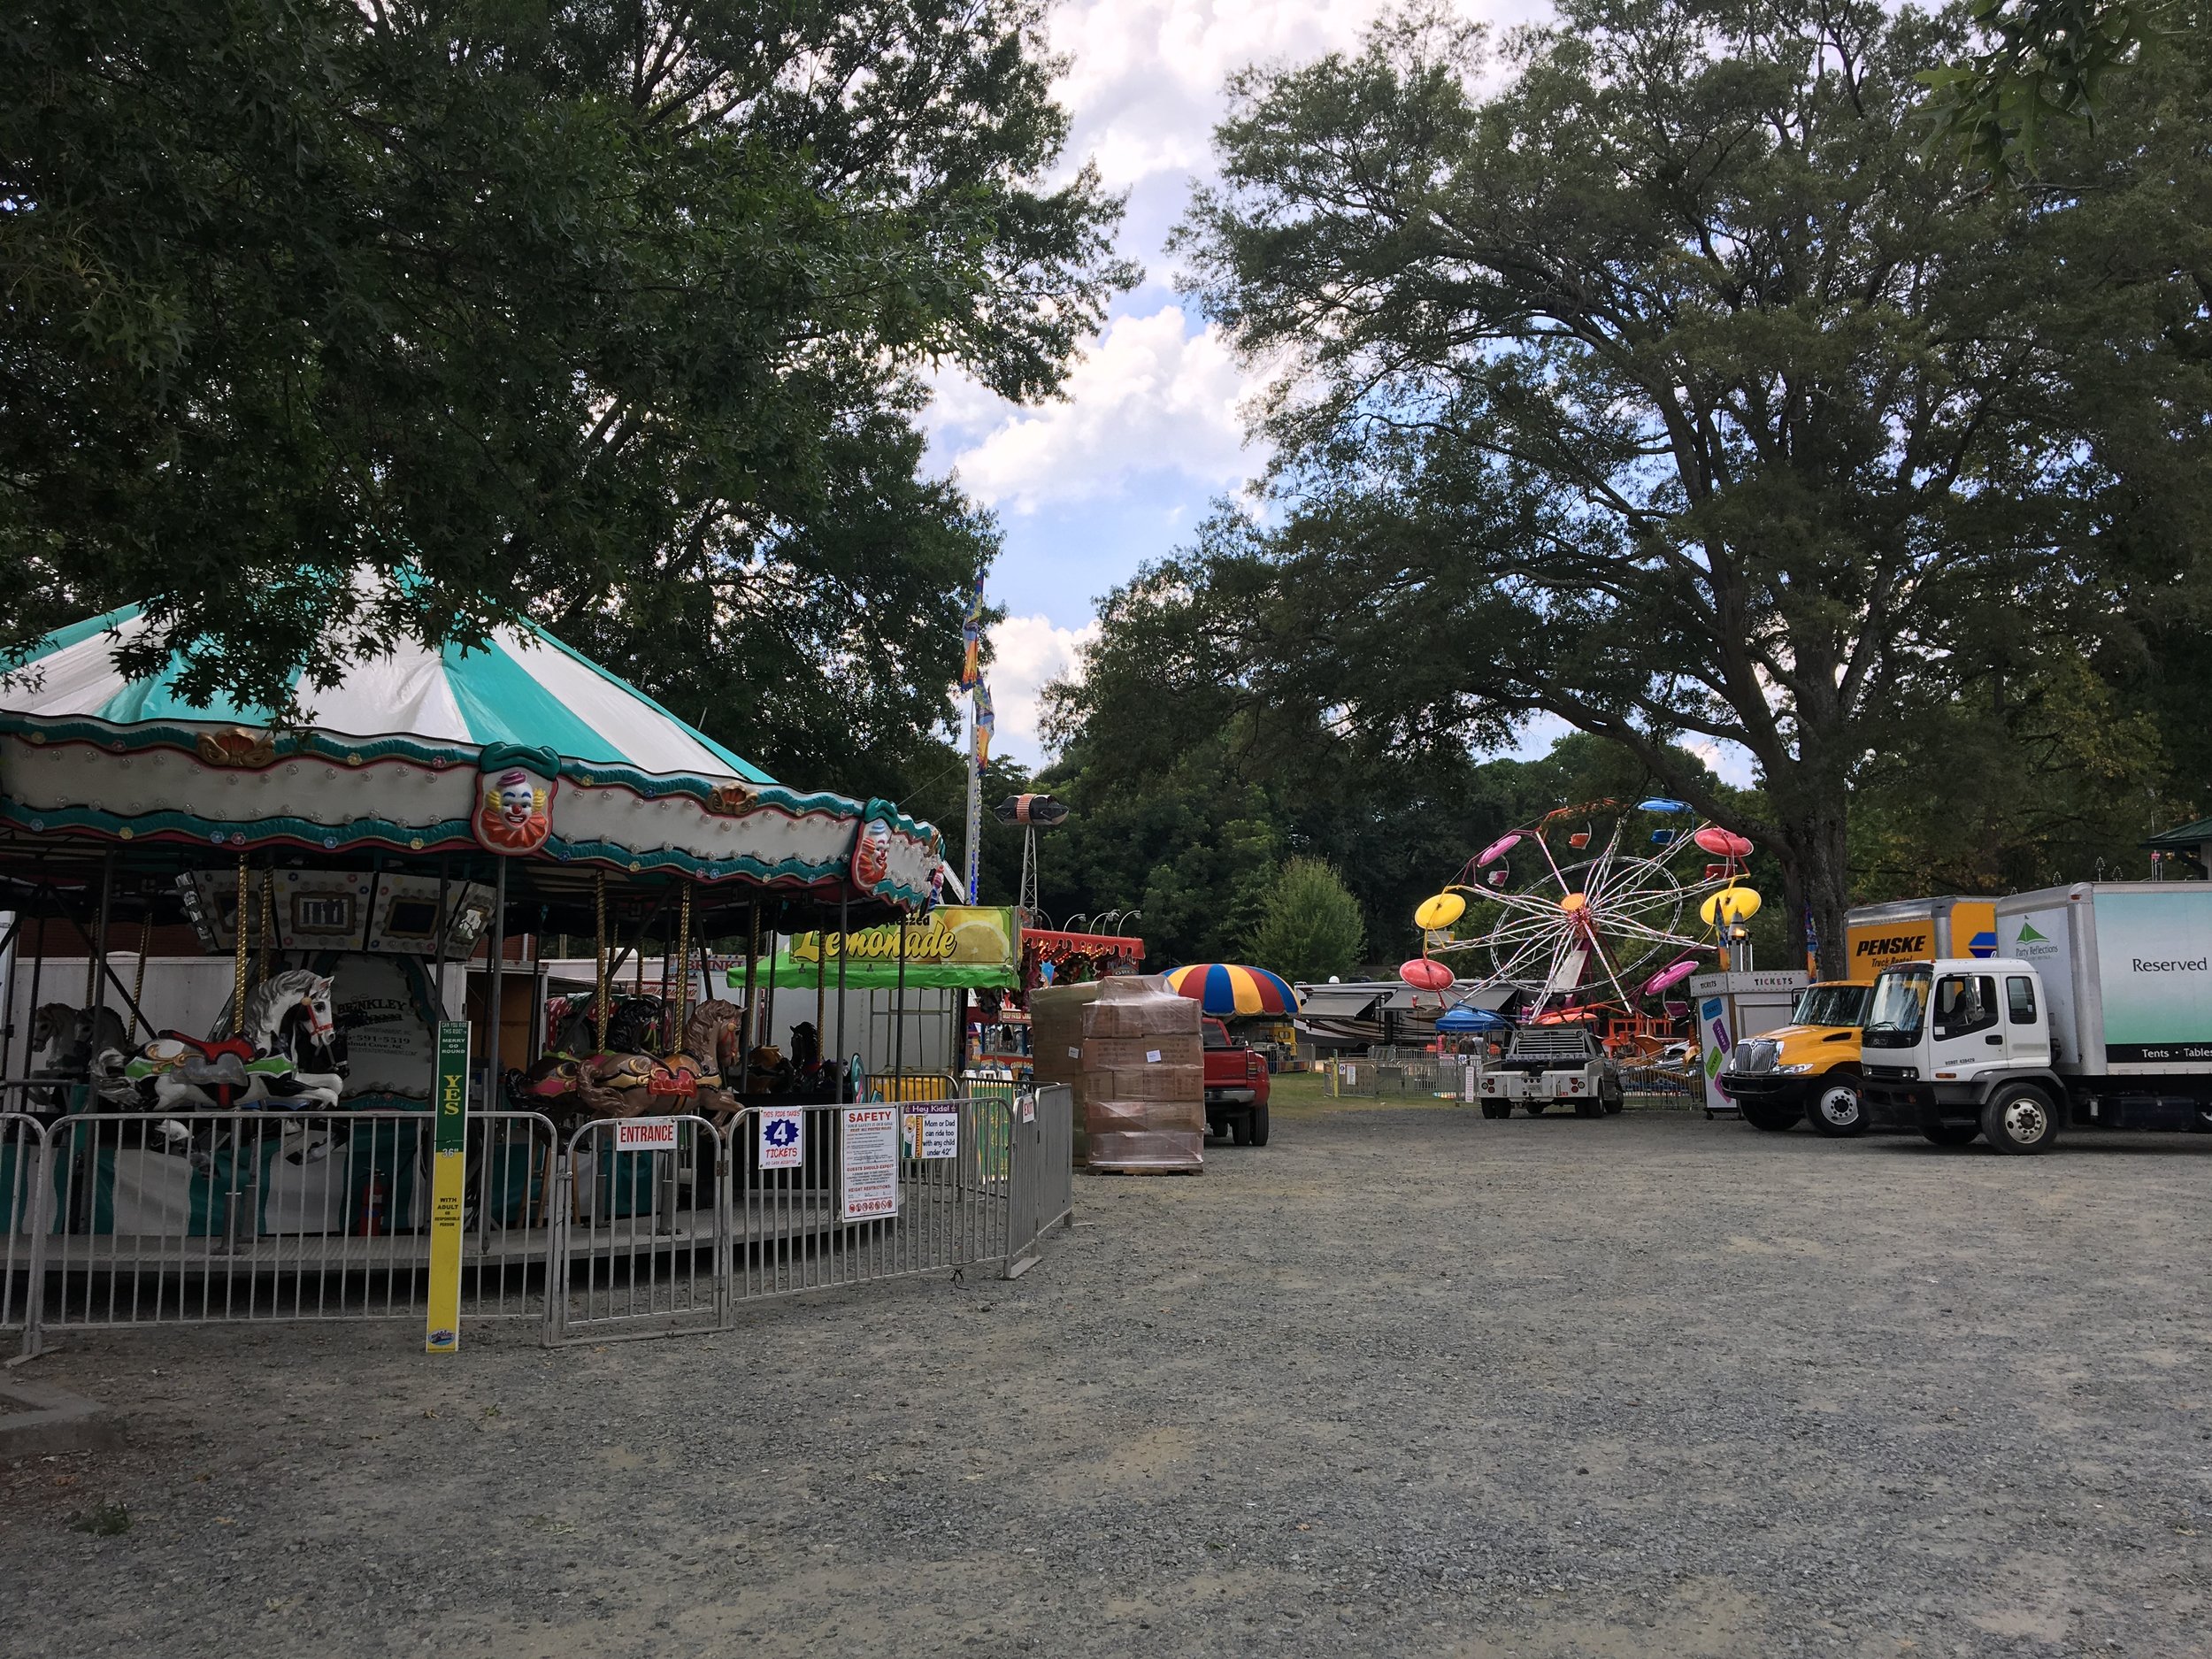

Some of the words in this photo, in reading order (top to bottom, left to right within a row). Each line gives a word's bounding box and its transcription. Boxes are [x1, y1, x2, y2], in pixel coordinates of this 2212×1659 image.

[794, 921, 957, 962] Lemonade
[1856, 935, 1926, 956] PENSKE
[2016, 948, 2029, 957] Party
[2030, 945, 2059, 956] Reflections
[1871, 958, 1891, 968] Truck
[2132, 957, 2208, 972] Reserved
[1700, 980, 1717, 989] TICKETS
[1755, 977, 1793, 986] TICKETS
[337, 998, 407, 1014] BRINKLEY
[2142, 1048, 2170, 1058] Tents
[443, 1075, 463, 1116] YES
[912, 1105, 929, 1114] Hey
[1024, 1102, 1033, 1116] EXIT
[849, 1111, 892, 1123] SAFETY
[620, 1125, 674, 1143] ENTRANCE
[773, 1122, 787, 1143] 4
[765, 1148, 798, 1158] TICKETS
